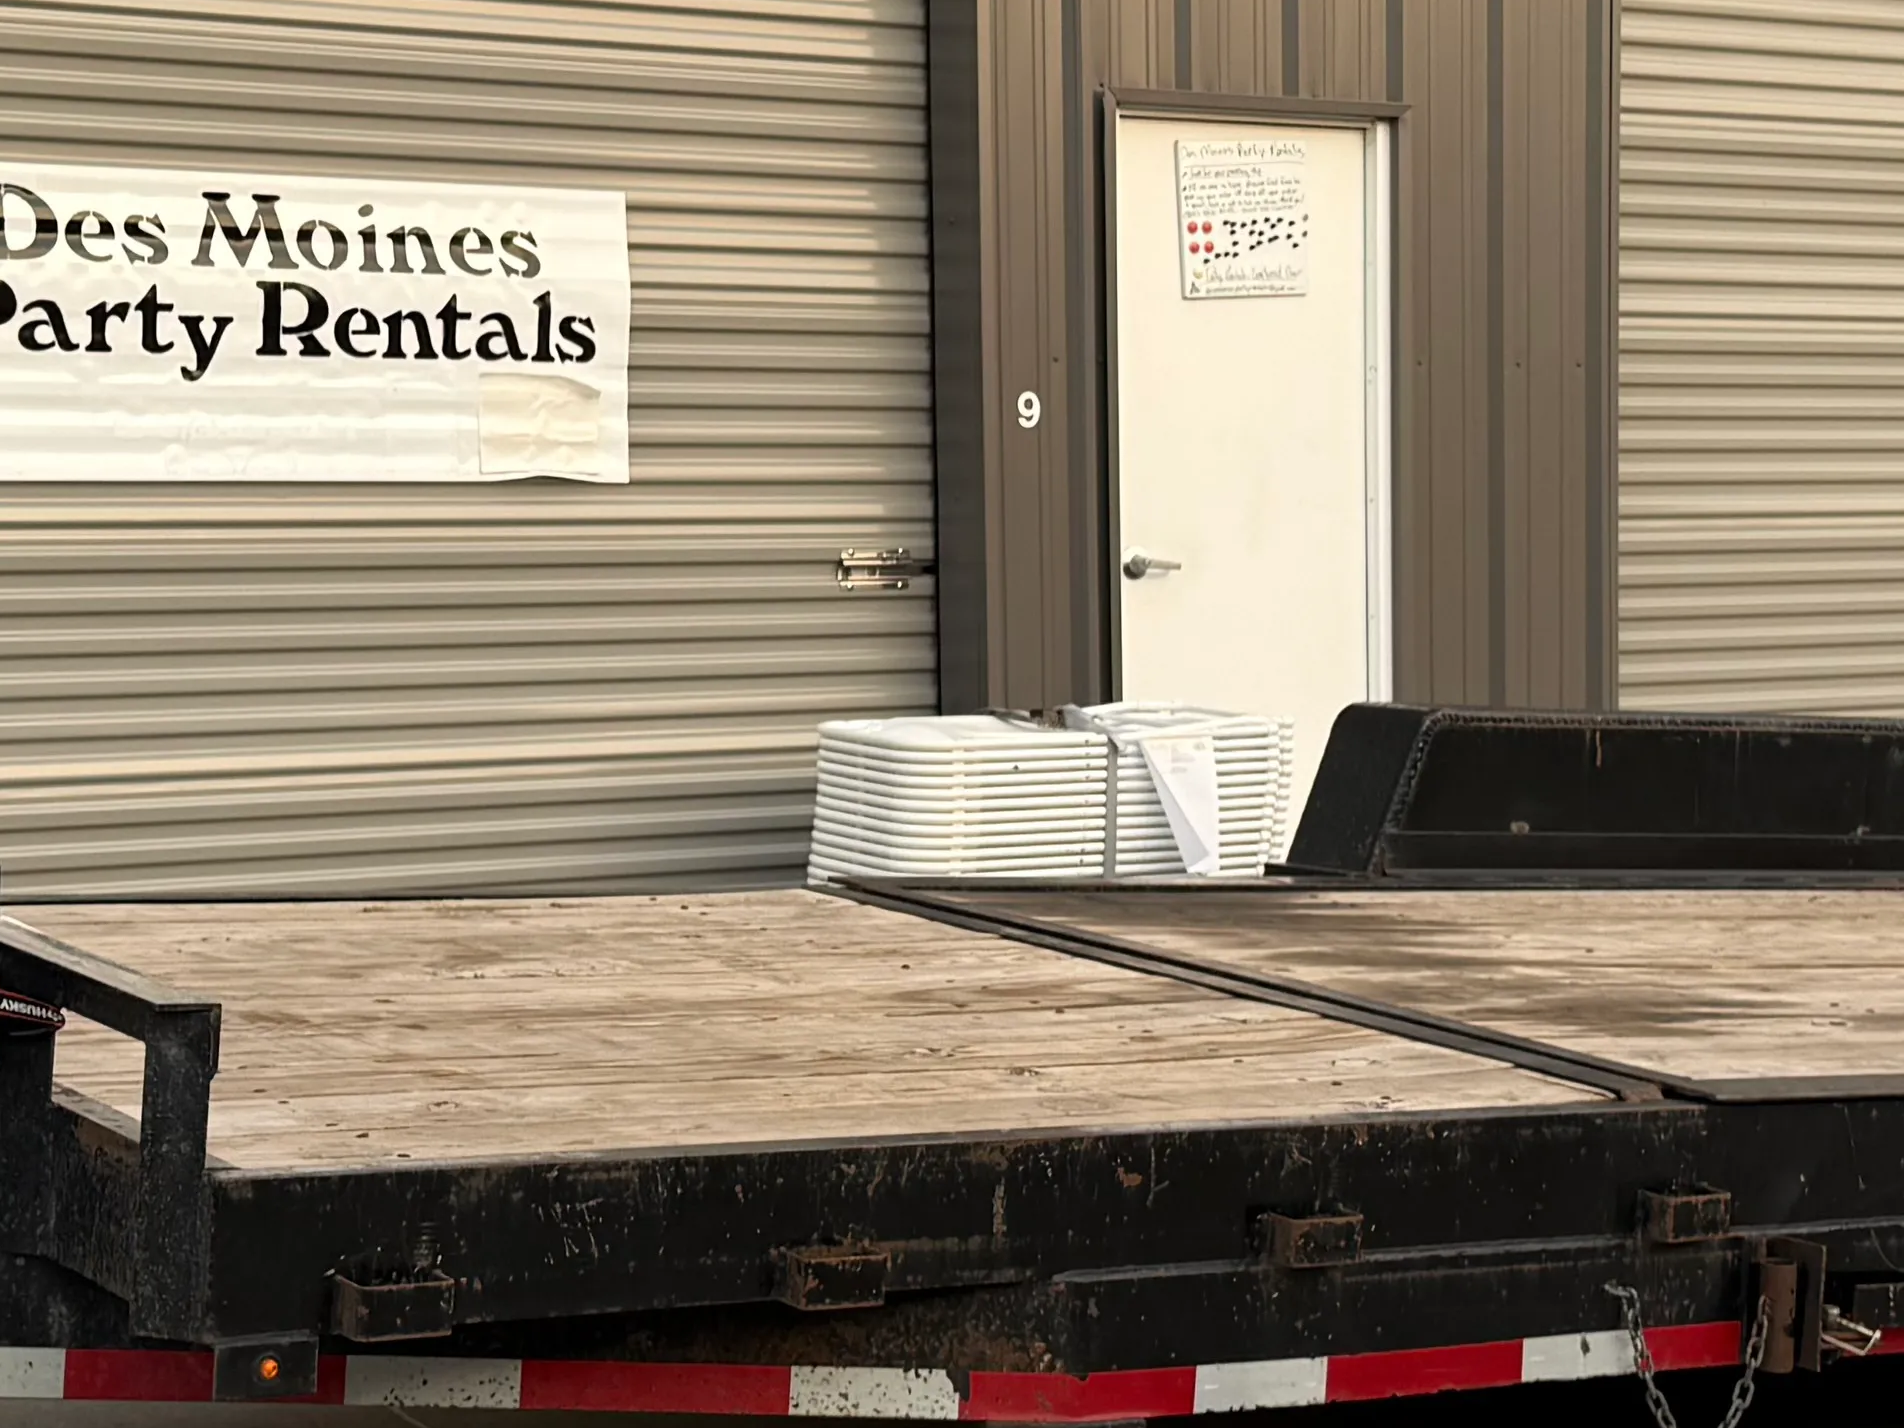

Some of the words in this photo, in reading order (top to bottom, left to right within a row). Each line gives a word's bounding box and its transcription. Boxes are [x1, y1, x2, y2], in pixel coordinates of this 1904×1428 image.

[191, 191, 542, 280] Moines
[255, 280, 598, 364] Rentals
[1017, 390, 1041, 428] 9
[0, 998, 48, 1019] HUSKY
